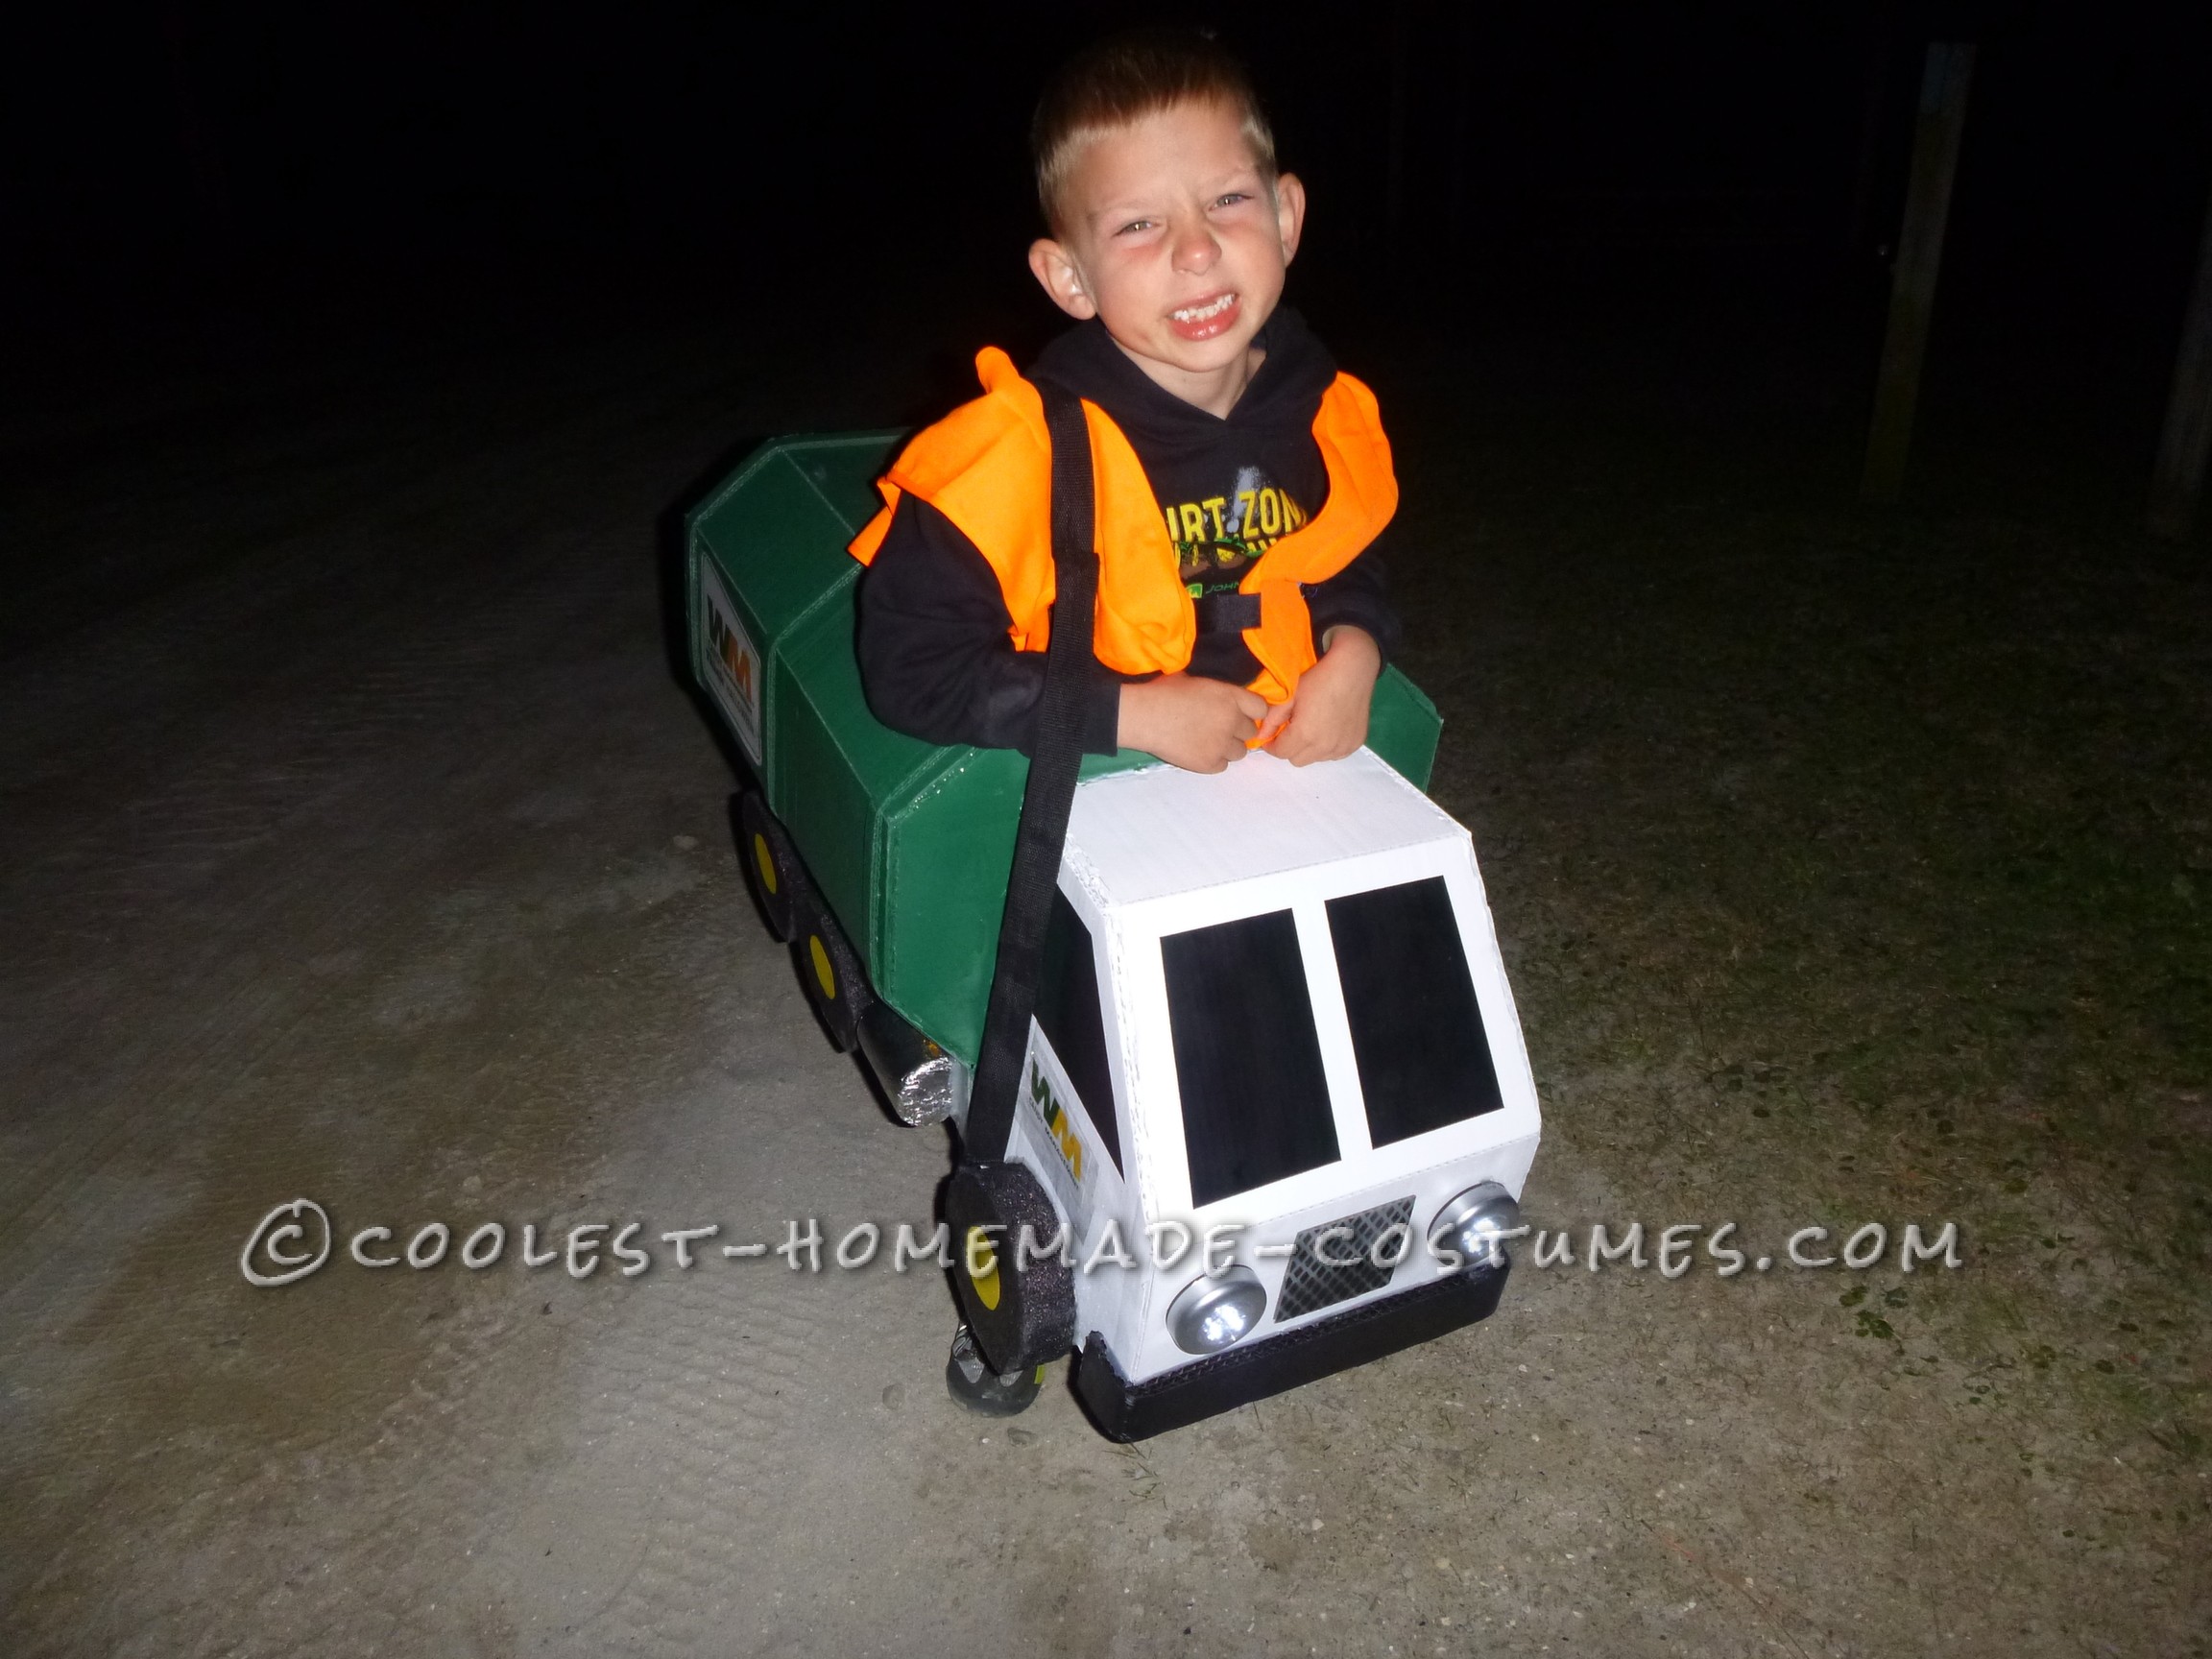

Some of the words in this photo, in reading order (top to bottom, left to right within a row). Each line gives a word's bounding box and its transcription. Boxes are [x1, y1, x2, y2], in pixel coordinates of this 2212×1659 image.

[1166, 496, 1226, 543] IRT
[1238, 487, 1306, 540] ZON
[707, 593, 753, 705] WM
[1031, 1058, 1083, 1182] WM
